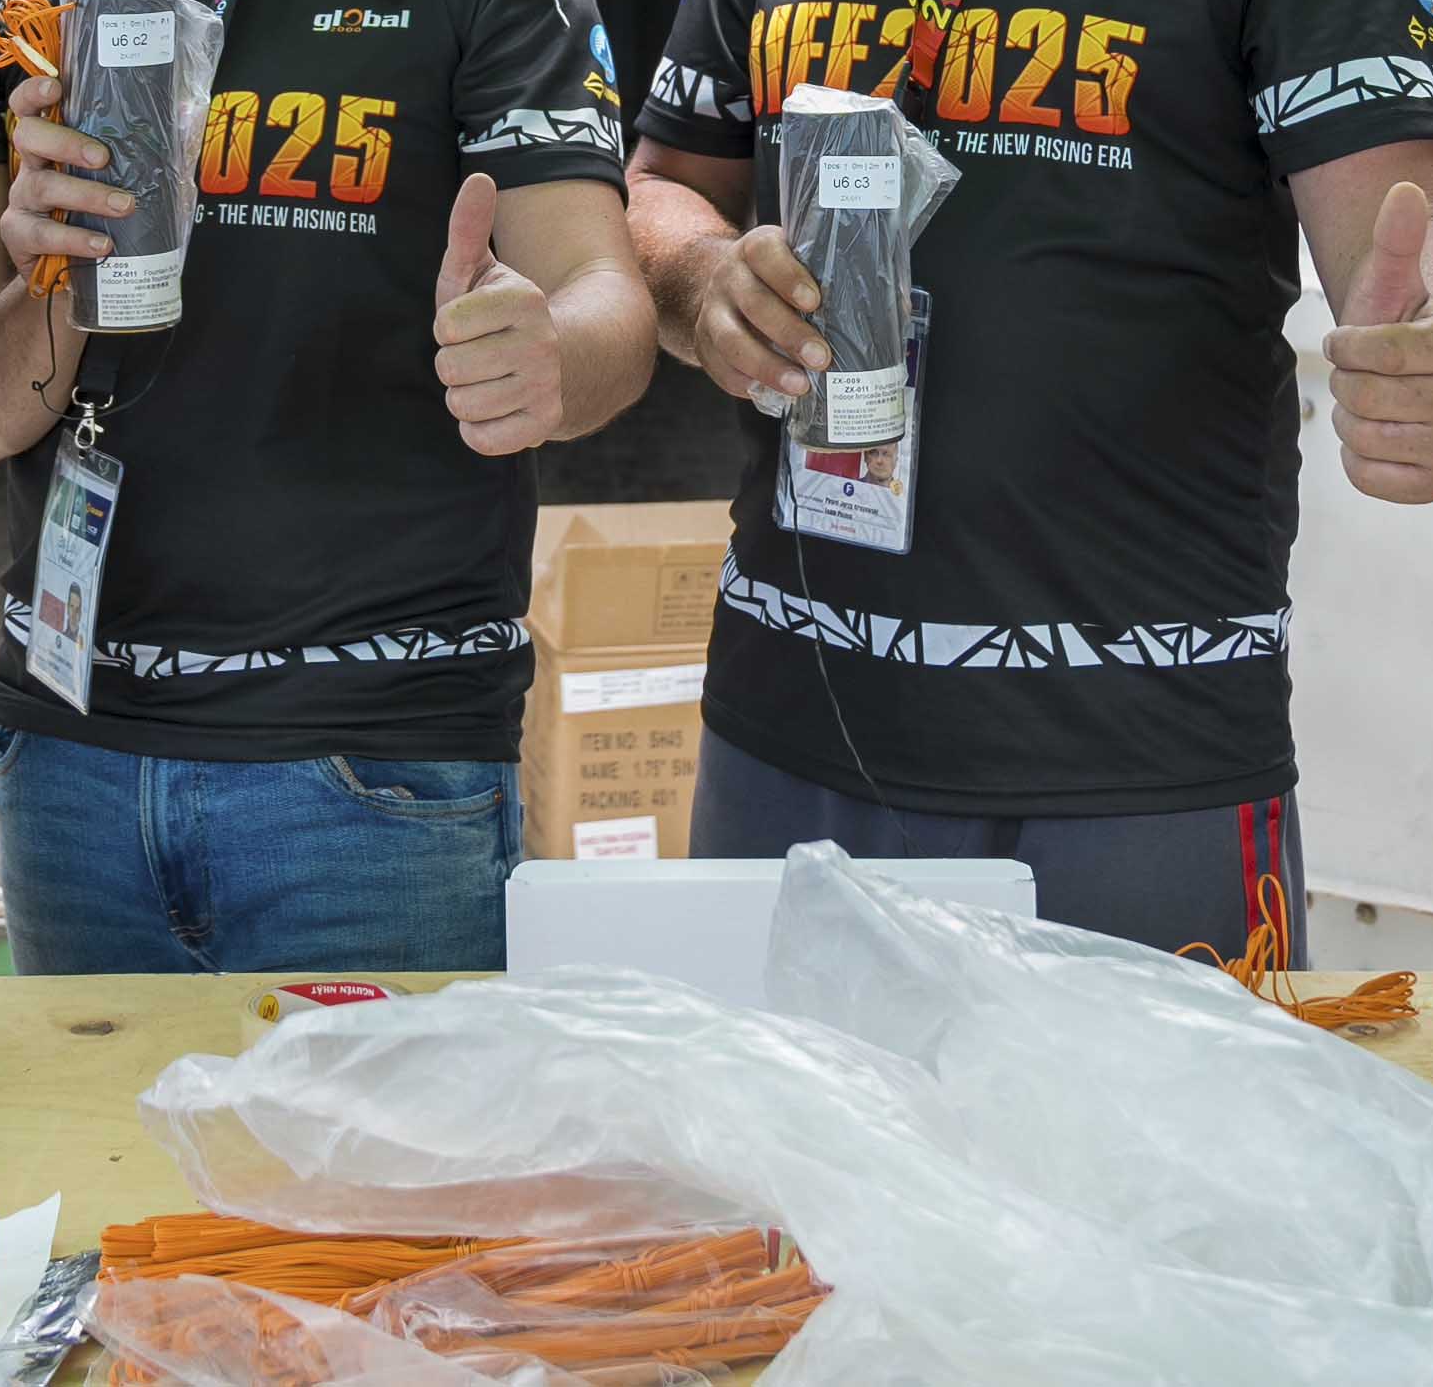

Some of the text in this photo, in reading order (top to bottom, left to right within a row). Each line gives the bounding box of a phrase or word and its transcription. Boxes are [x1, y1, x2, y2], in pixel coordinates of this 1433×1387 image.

[312, 8, 411, 32] global
[111, 34, 129, 47] u6
[132, 33, 149, 47] c2
[957, 130, 989, 153] THE
[992, 132, 1031, 156] NEW
[1035, 136, 1092, 165] RISING
[1098, 144, 1134, 170] ERA
[832, 176, 851, 190] u6
[854, 176, 871, 190] c3
[218, 203, 249, 226] THE
[251, 205, 289, 228] NEW
[292, 207, 347, 232] RISING
[350, 212, 378, 235] ERA
